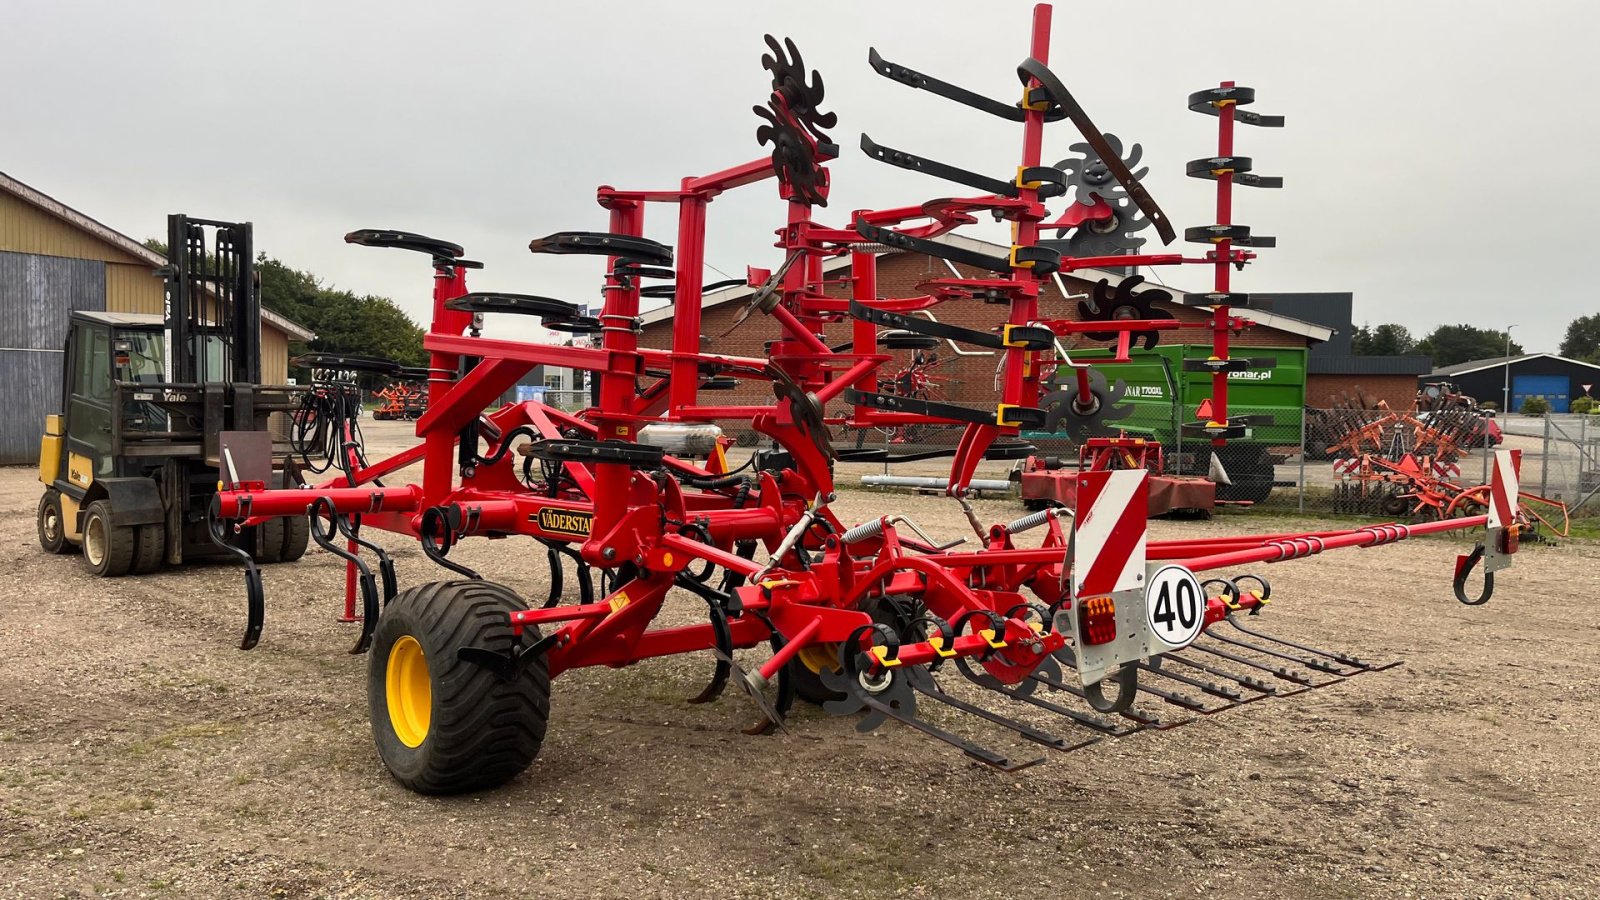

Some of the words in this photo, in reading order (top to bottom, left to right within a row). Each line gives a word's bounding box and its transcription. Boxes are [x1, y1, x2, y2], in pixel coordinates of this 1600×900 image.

[1228, 370, 1272, 380] ronar.pl
[163, 393, 188, 402] Yale
[1153, 578, 1196, 632] 40
